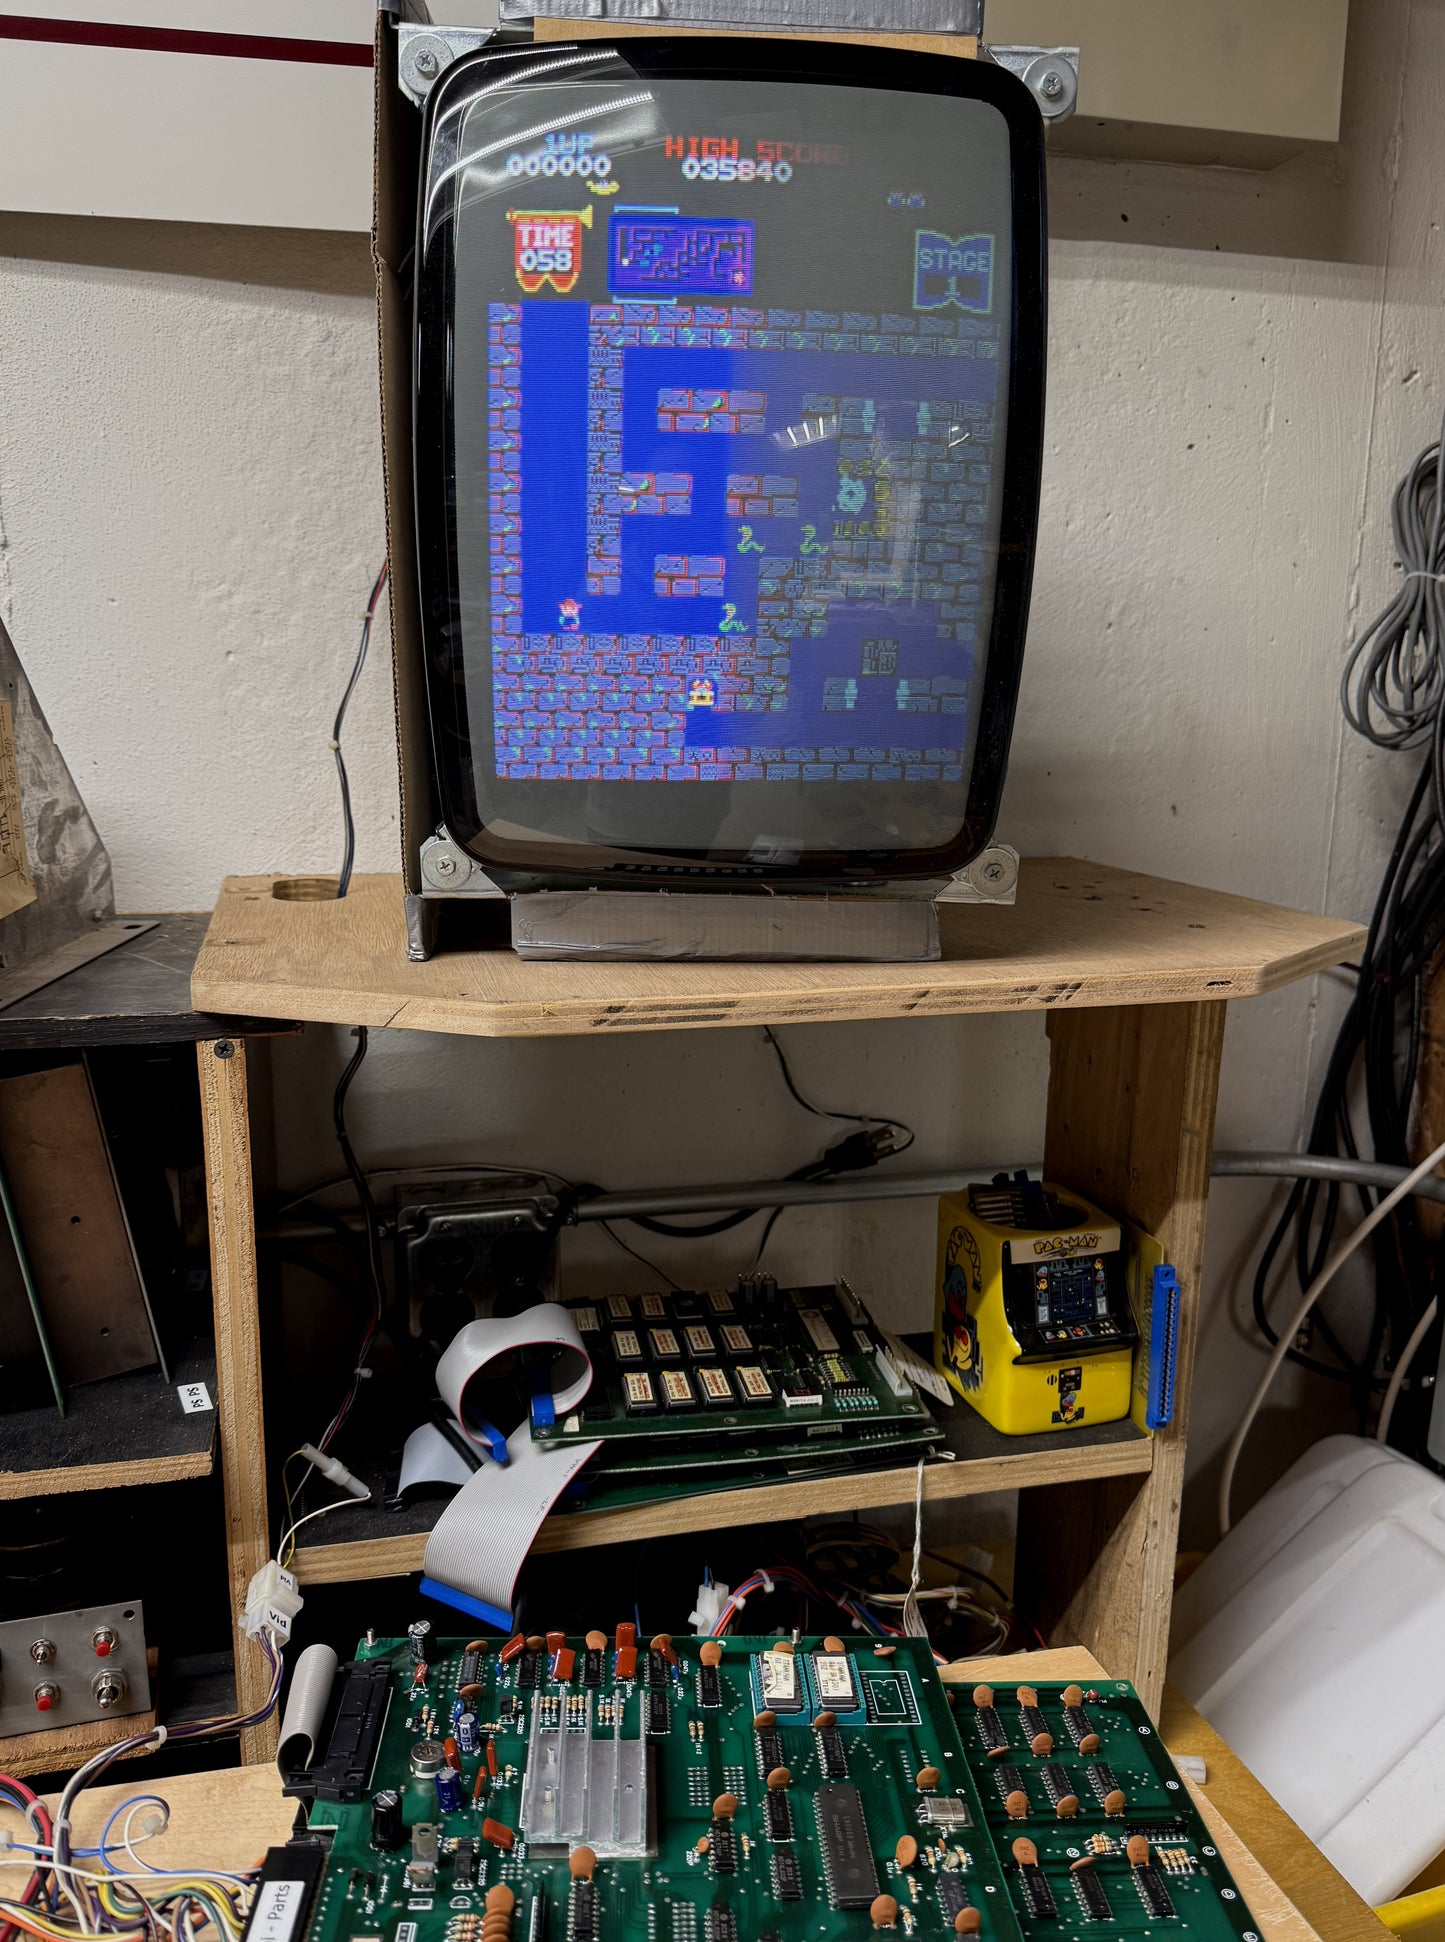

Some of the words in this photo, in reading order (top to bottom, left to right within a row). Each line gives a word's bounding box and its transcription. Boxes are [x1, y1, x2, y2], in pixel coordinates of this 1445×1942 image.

[664, 136, 739, 160] HIGH
[505, 153, 612, 177] 000000
[681, 157, 793, 183] 035840
[518, 224, 575, 248] TIME
[519, 250, 574, 272] 058
[918, 247, 990, 273] STAGE
[269, 1611, 287, 1629] Vid
[832, 1814, 843, 1842] SHARP
[267, 1884, 291, 1921] Parts
